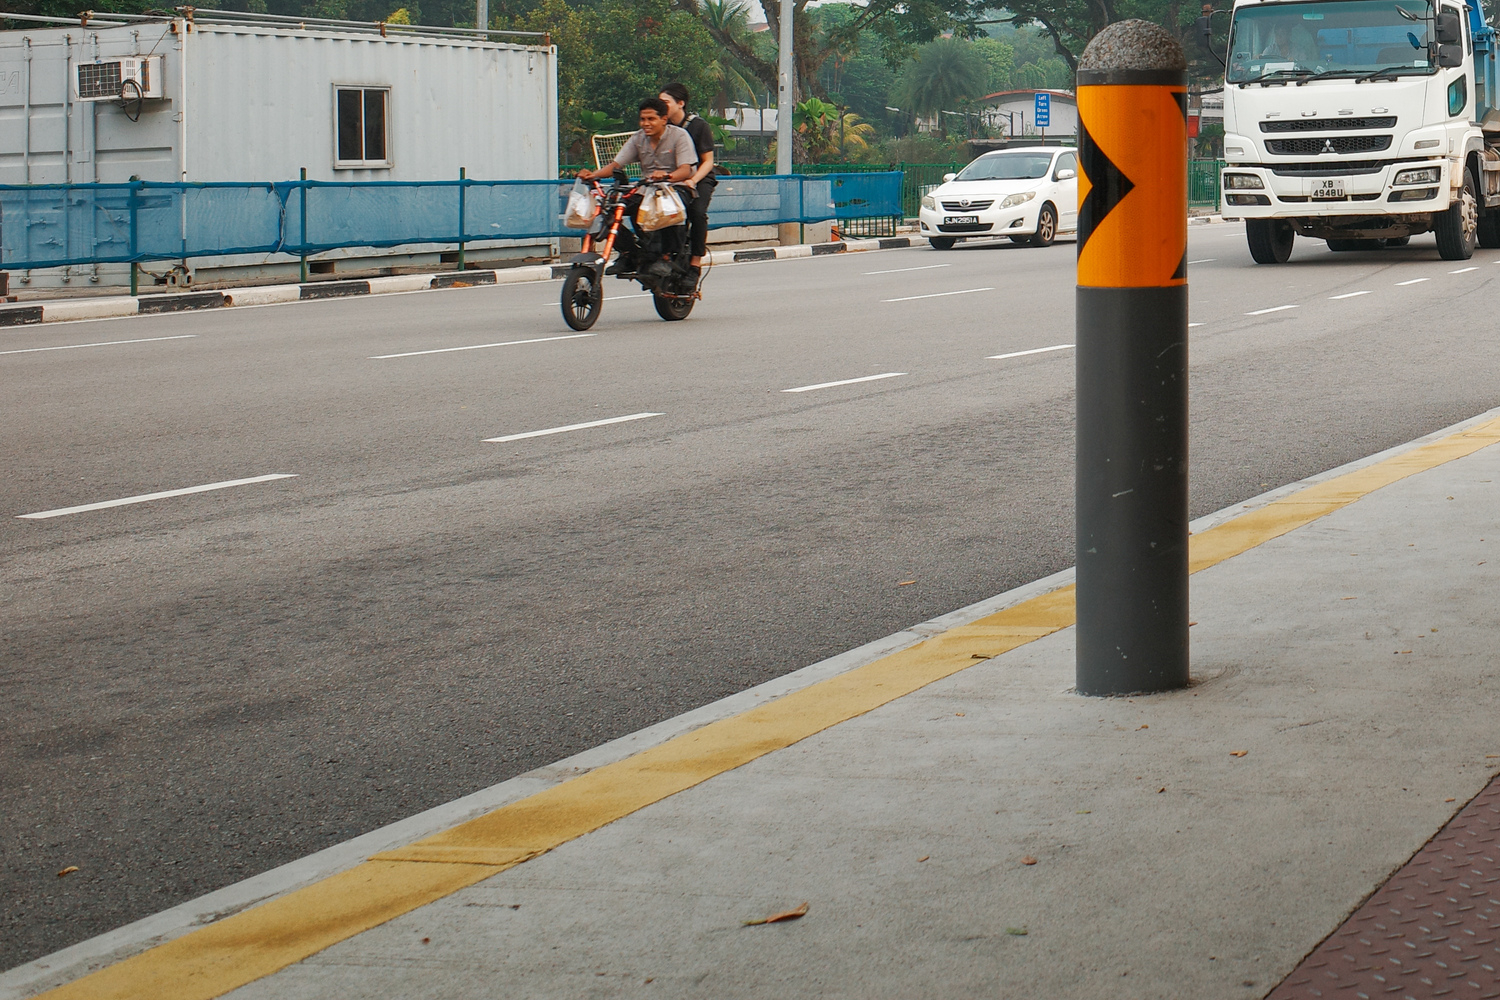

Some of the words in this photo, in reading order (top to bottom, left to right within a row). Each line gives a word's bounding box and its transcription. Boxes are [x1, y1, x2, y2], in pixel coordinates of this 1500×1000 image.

[1265, 106, 1389, 118] FUSO
[1322, 180, 1333, 188] XB
[1313, 189, 1343, 197] 4948U
